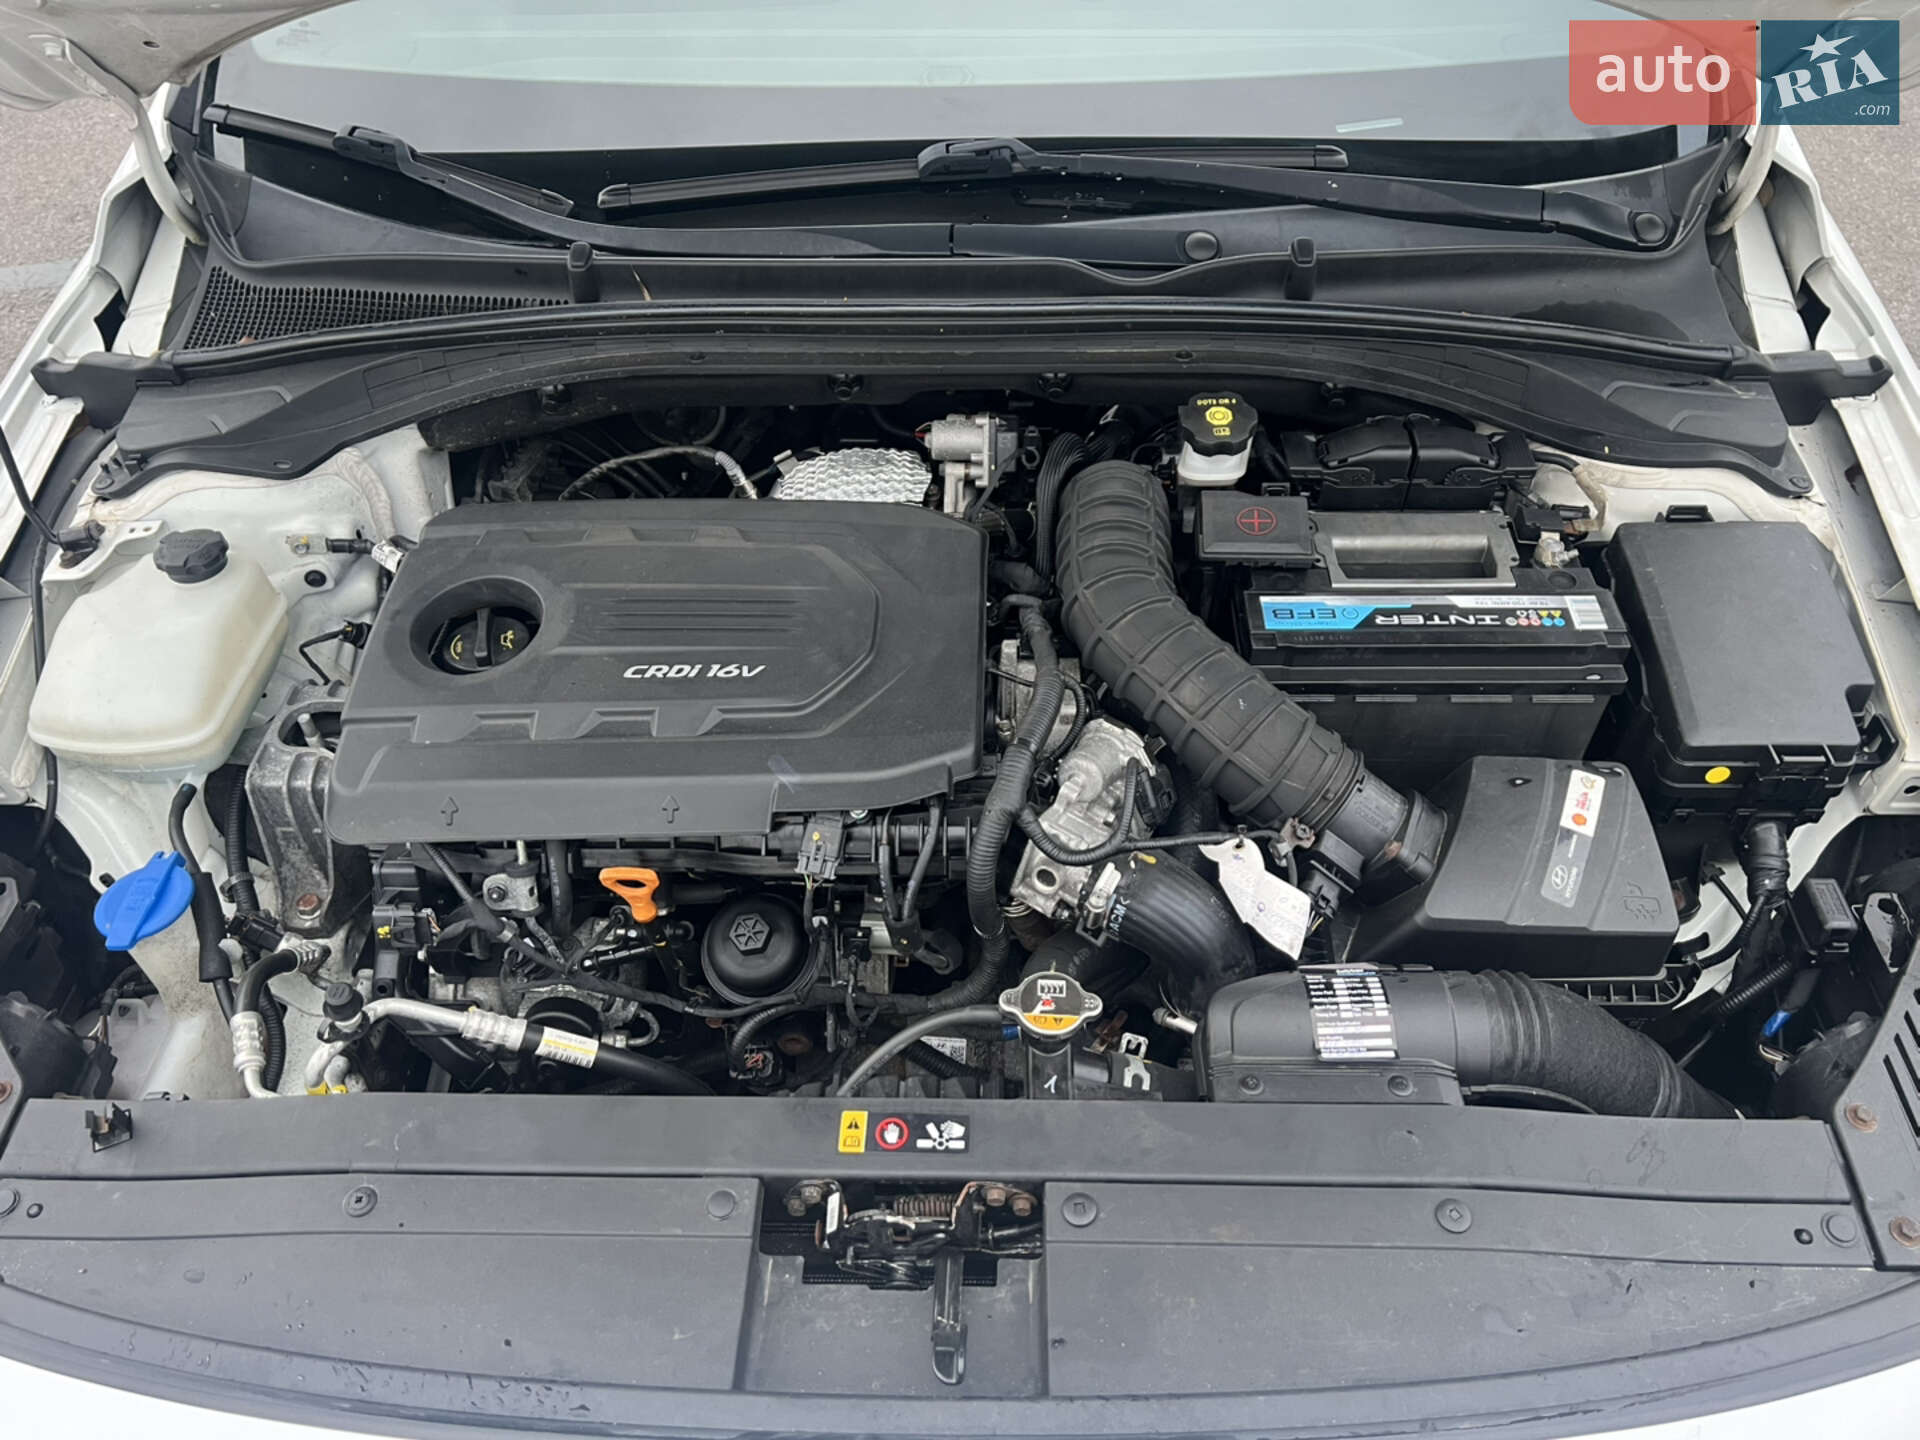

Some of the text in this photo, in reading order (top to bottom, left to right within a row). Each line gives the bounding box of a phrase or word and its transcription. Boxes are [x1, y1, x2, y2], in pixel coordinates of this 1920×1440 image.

[1271, 608, 1337, 620] EFB
[1375, 613, 1501, 626] INTER
[706, 663, 767, 678] 16V
